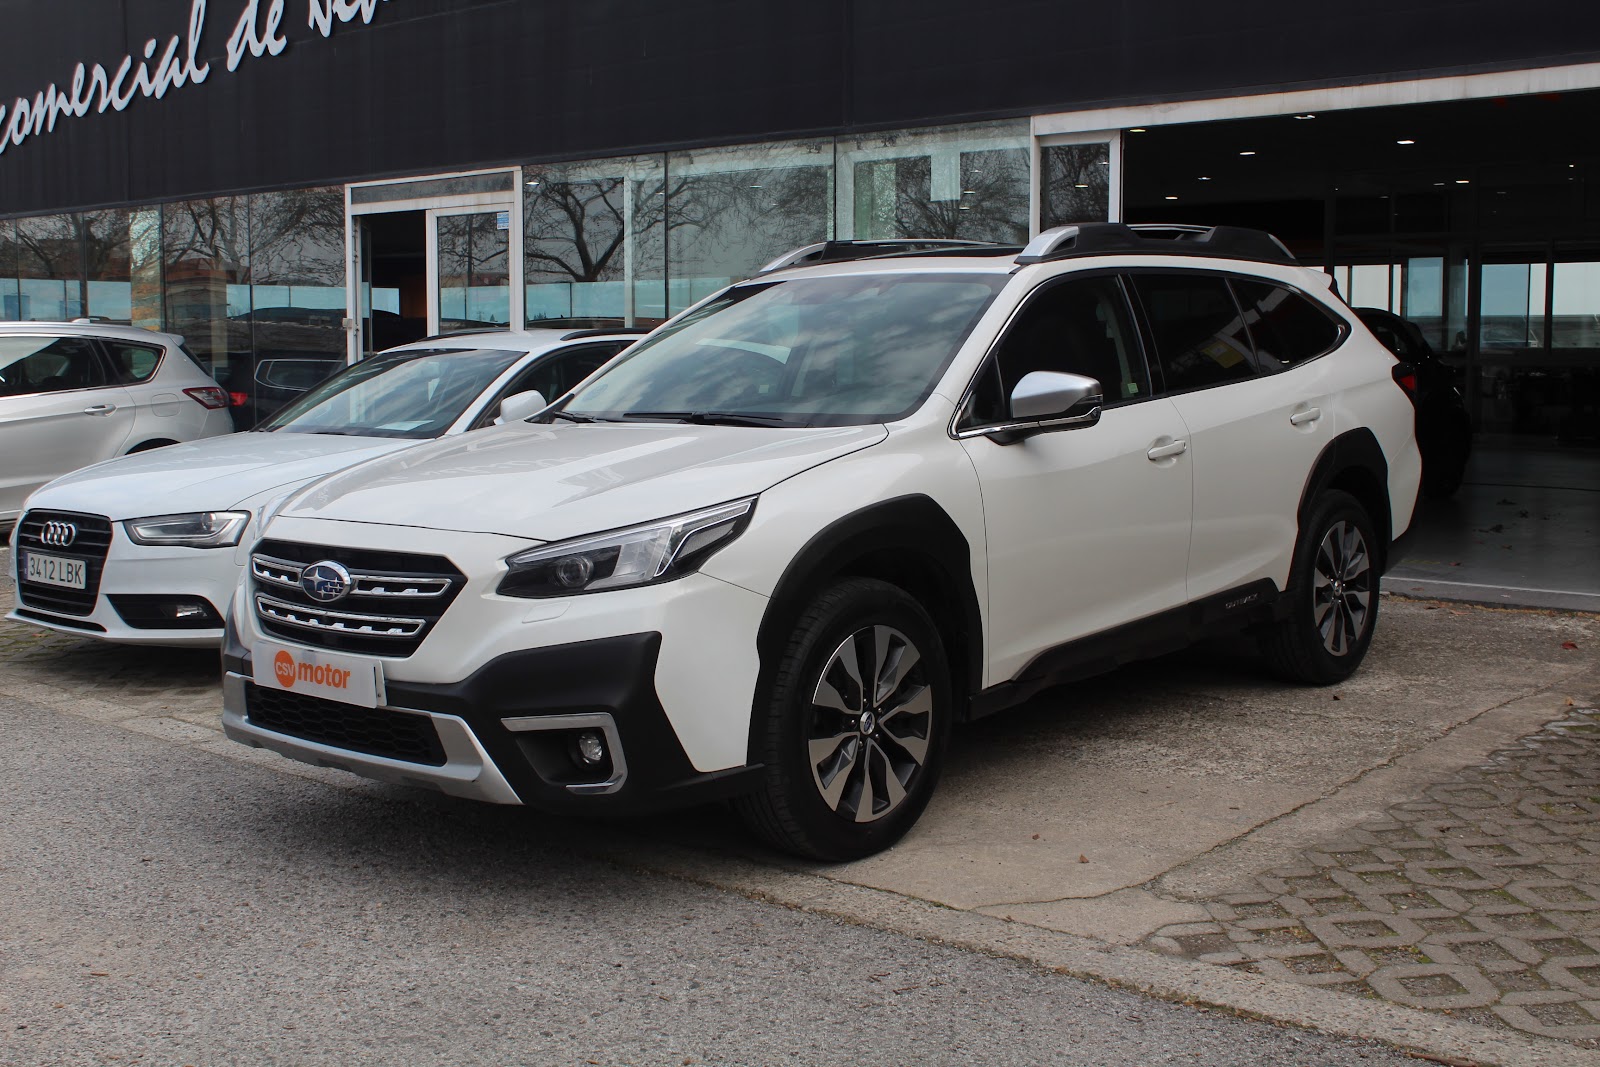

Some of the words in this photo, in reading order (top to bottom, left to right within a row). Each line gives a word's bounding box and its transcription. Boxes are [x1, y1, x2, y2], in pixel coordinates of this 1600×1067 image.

[226, 0, 287, 72] de
[29, 556, 56, 581] 3412
[59, 562, 84, 585] LBK
[275, 660, 296, 678] CSV
[297, 661, 351, 689] motor
